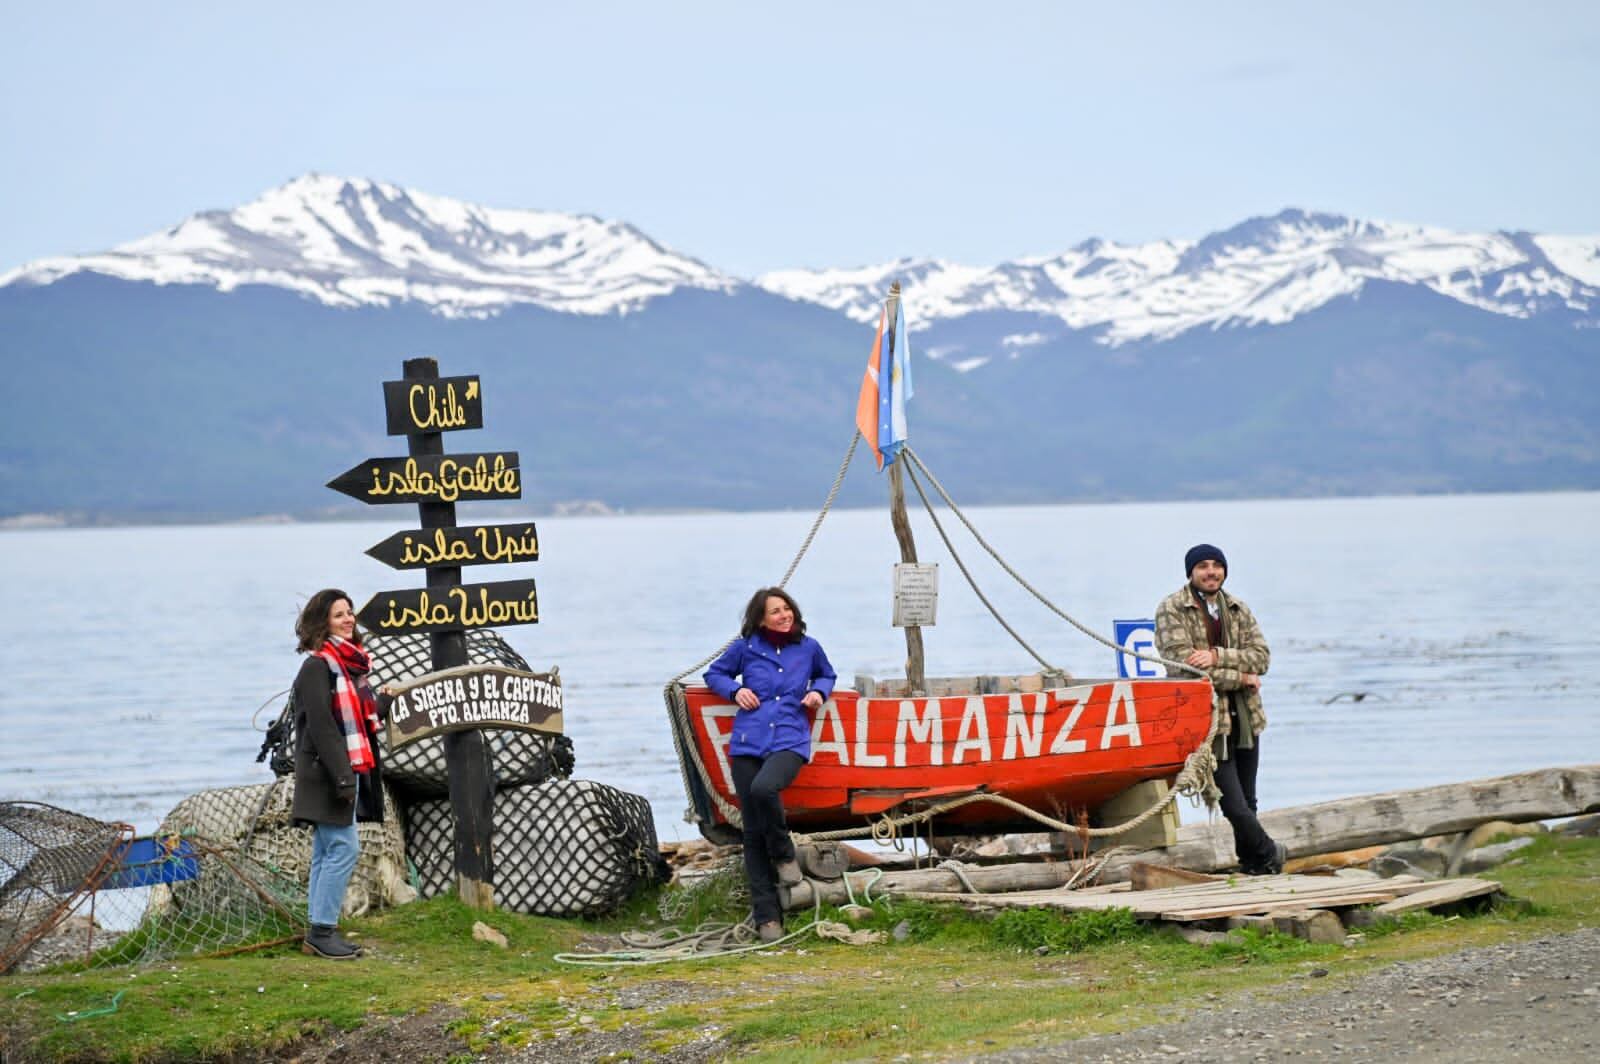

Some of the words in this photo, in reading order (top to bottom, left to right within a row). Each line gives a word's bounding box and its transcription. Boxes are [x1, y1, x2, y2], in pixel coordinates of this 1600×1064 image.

[409, 383, 466, 428] Chile
[368, 458, 437, 495] isla
[438, 455, 519, 501] Gable
[400, 528, 476, 564] isla
[475, 527, 537, 562] Upú
[380, 591, 455, 628] isla
[391, 696, 411, 723] LA
[411, 678, 466, 713] SIRENA
[483, 674, 500, 699] EL
[502, 675, 562, 709] CAPITÁN
[428, 704, 461, 728] PTO.
[463, 700, 530, 724] ALMANZA
[809, 680, 1142, 767] ALMANZA
